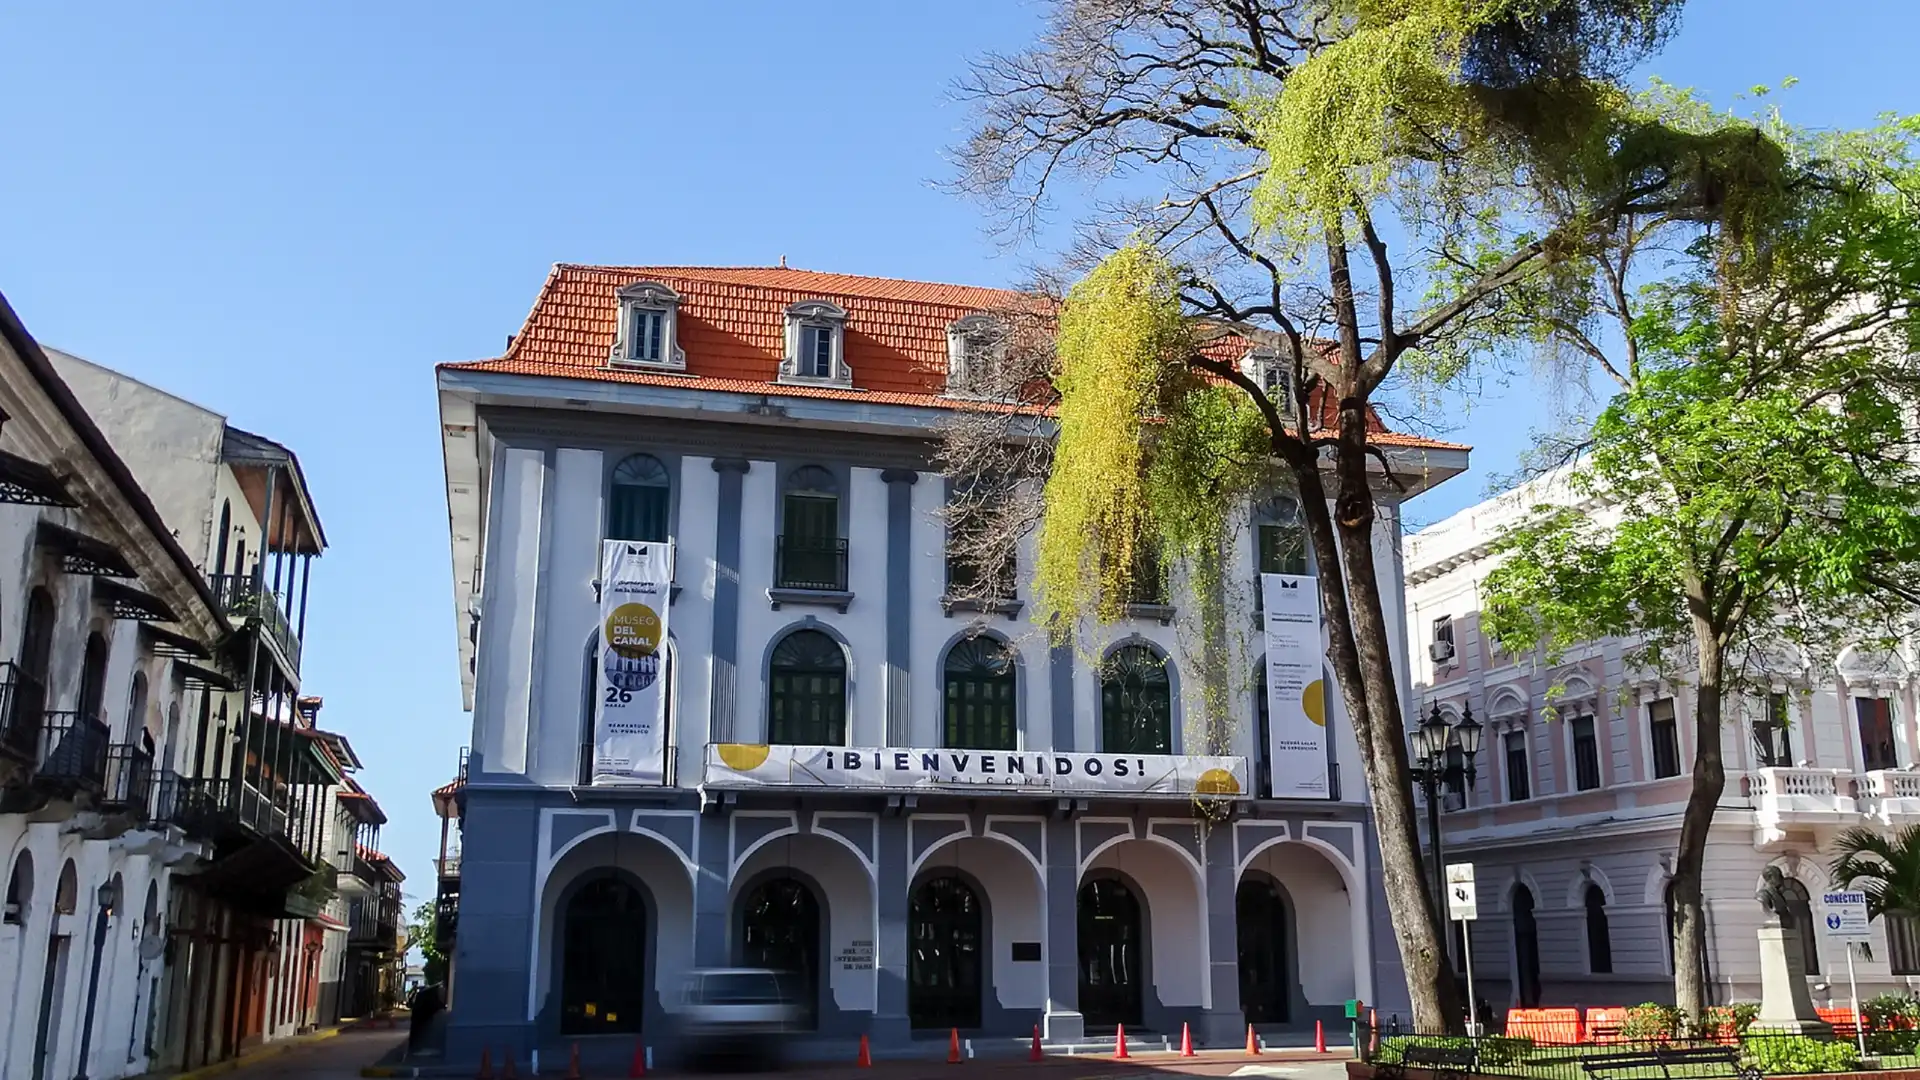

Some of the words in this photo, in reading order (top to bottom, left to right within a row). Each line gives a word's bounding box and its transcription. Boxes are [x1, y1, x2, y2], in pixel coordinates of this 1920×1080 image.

[614, 615, 655, 626] MUSEO
[613, 625, 636, 635] DEL
[613, 636, 653, 646] CANAL
[605, 686, 632, 703] 26
[826, 751, 1145, 777] ¡BIENVENIDOS!
[930, 775, 1051, 785] WELCOME
[1823, 893, 1865, 903] CONÉCTATE
